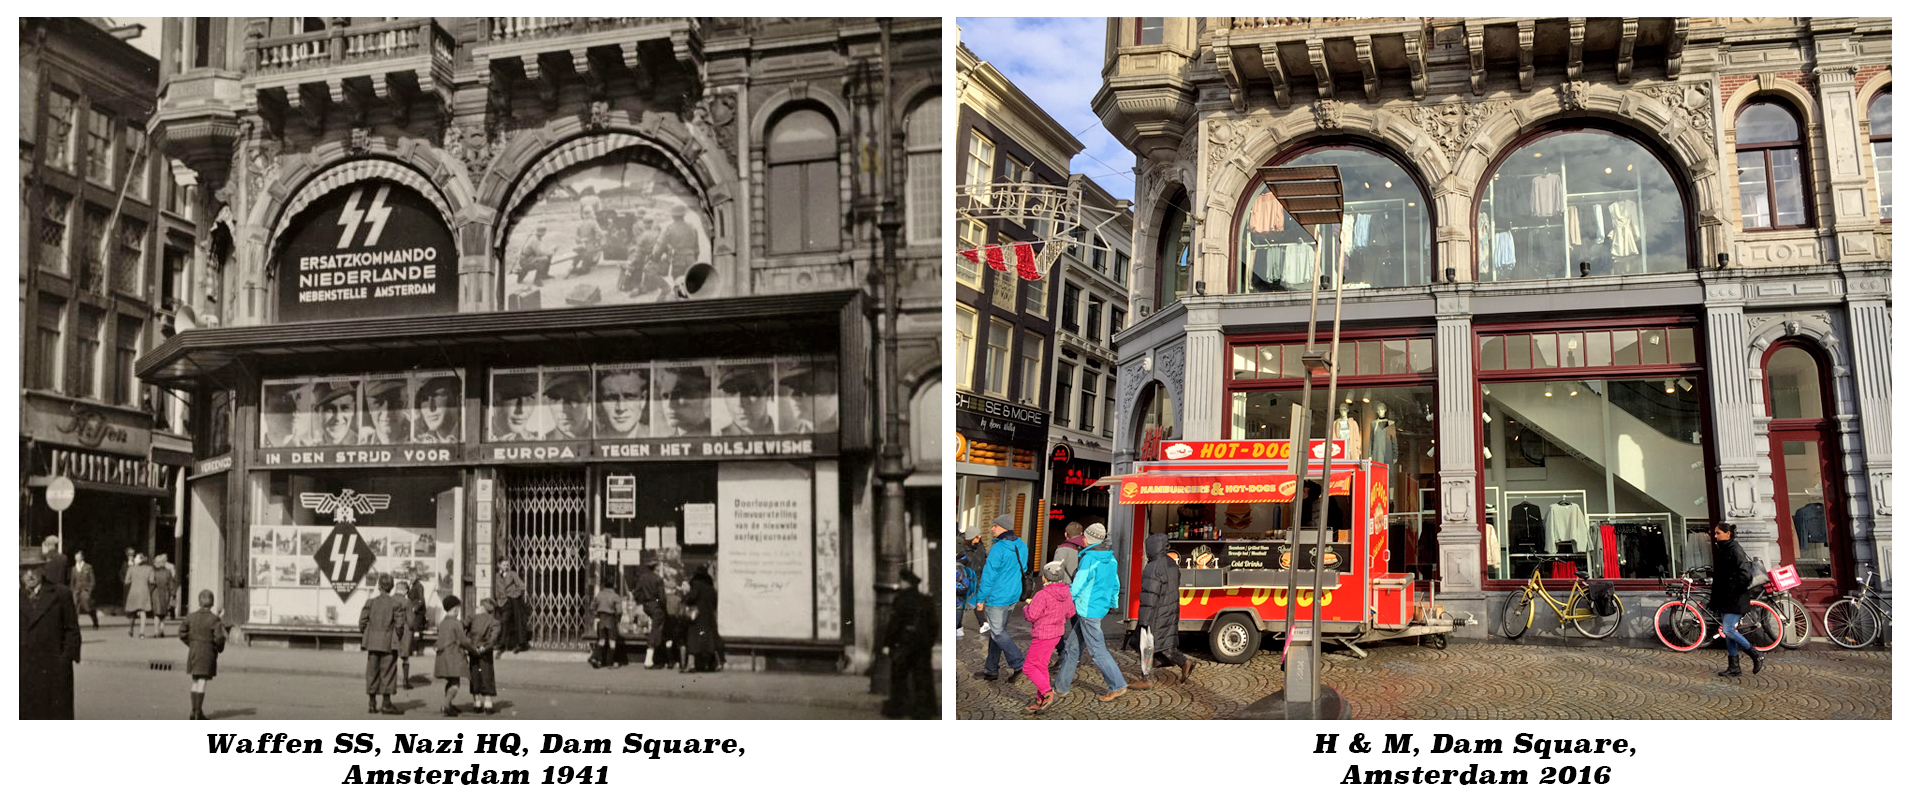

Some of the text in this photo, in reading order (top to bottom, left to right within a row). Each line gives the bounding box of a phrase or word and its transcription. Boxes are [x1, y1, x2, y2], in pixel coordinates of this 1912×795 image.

[300, 247, 437, 271] ERSATZKOMMANDO
[300, 264, 437, 289] NIEDERLANDE
[299, 283, 436, 303] NEBENSTELLE AMSTERDAM
[1002, 405, 1010, 417] &
[1011, 407, 1042, 424] MORE
[266, 453, 281, 465] IN
[291, 451, 324, 464] DEN
[404, 449, 450, 461] VOOR
[493, 445, 575, 460] EUROPA
[601, 439, 813, 458] TEGEN HET BOLSJEWISME
[1140, 481, 1276, 495] HAMBURGERS & HOT-DOGS
[1231, 560, 1263, 568] Cold Drinks
